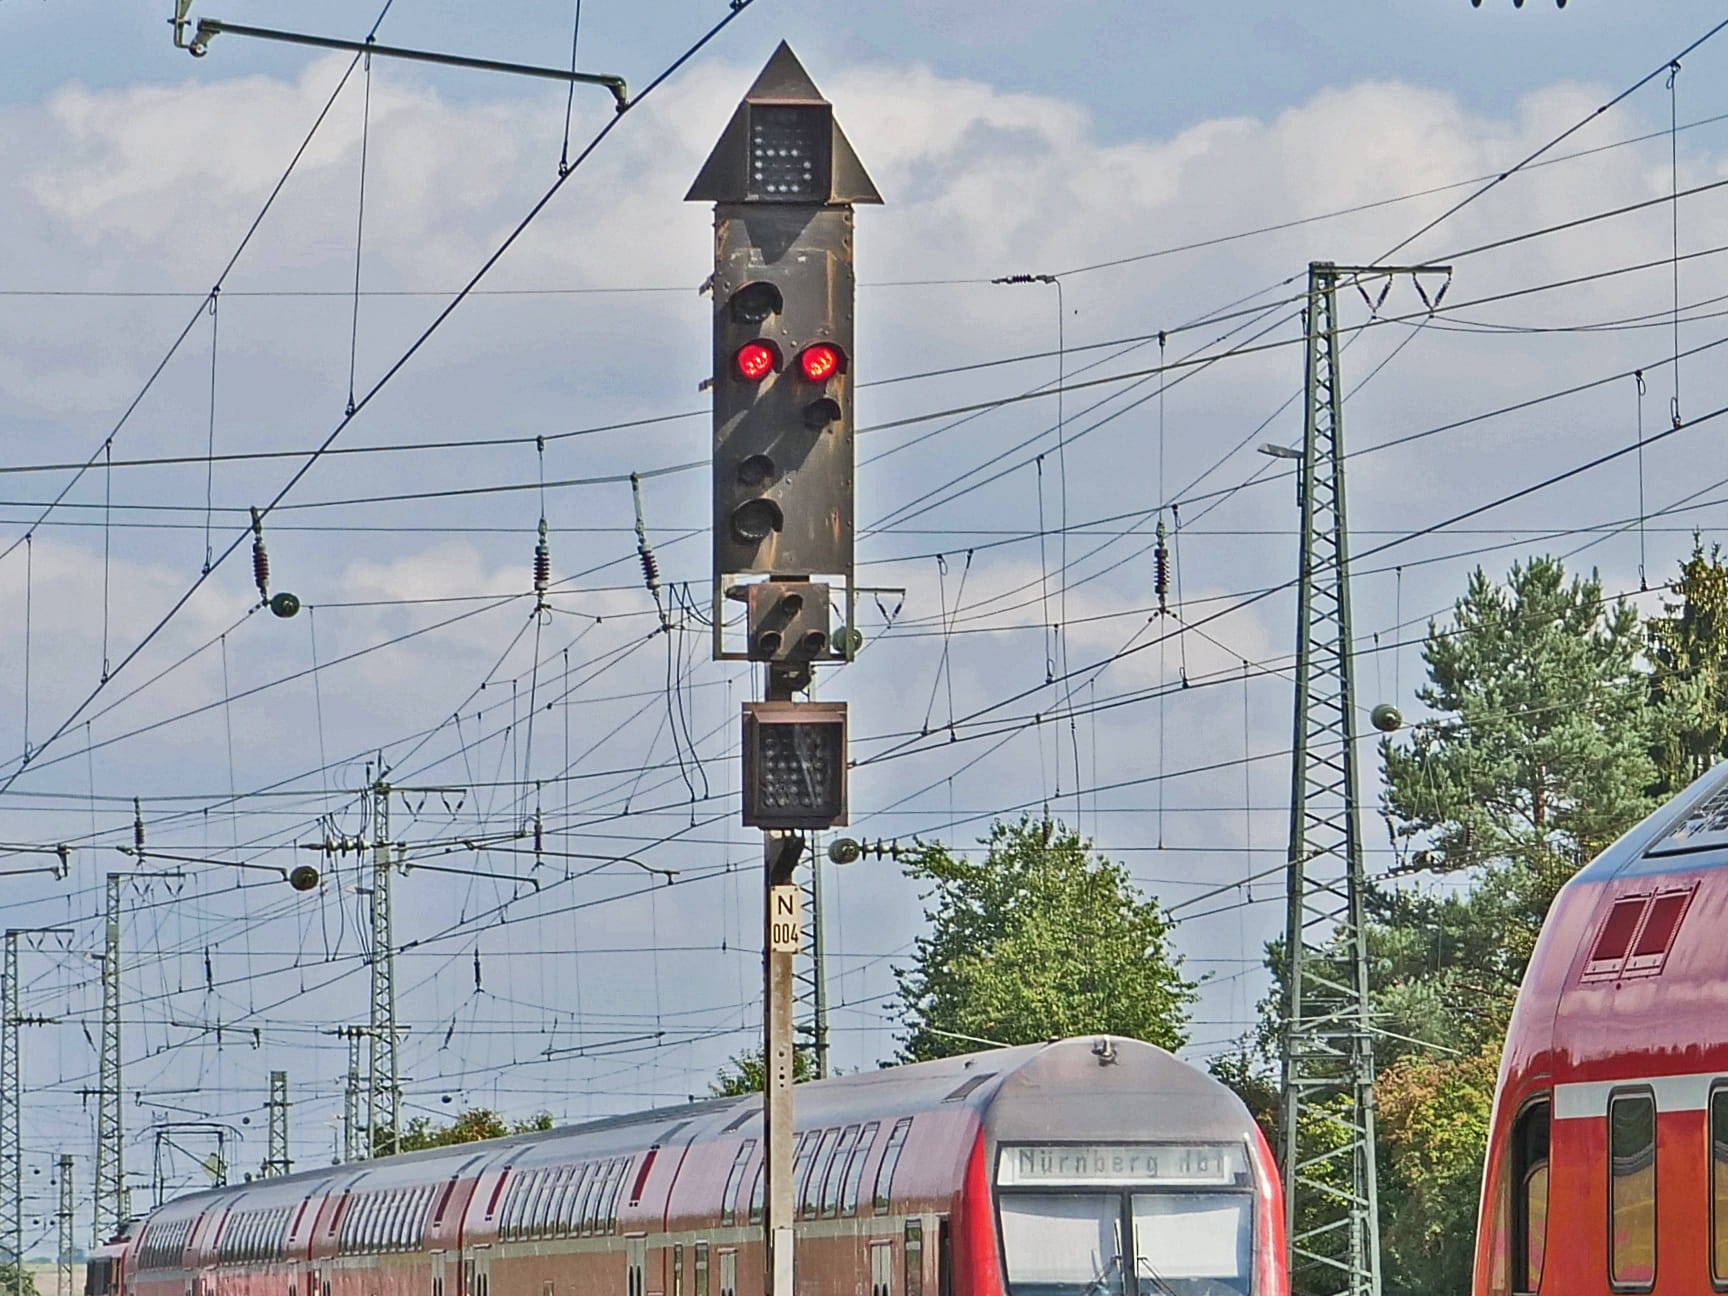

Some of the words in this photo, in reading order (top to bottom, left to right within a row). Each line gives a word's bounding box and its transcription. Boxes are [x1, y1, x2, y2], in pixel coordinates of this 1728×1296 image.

[778, 894, 793, 915] N
[773, 923, 799, 943] 004
[1018, 1148, 1159, 1176] Nürnberg
